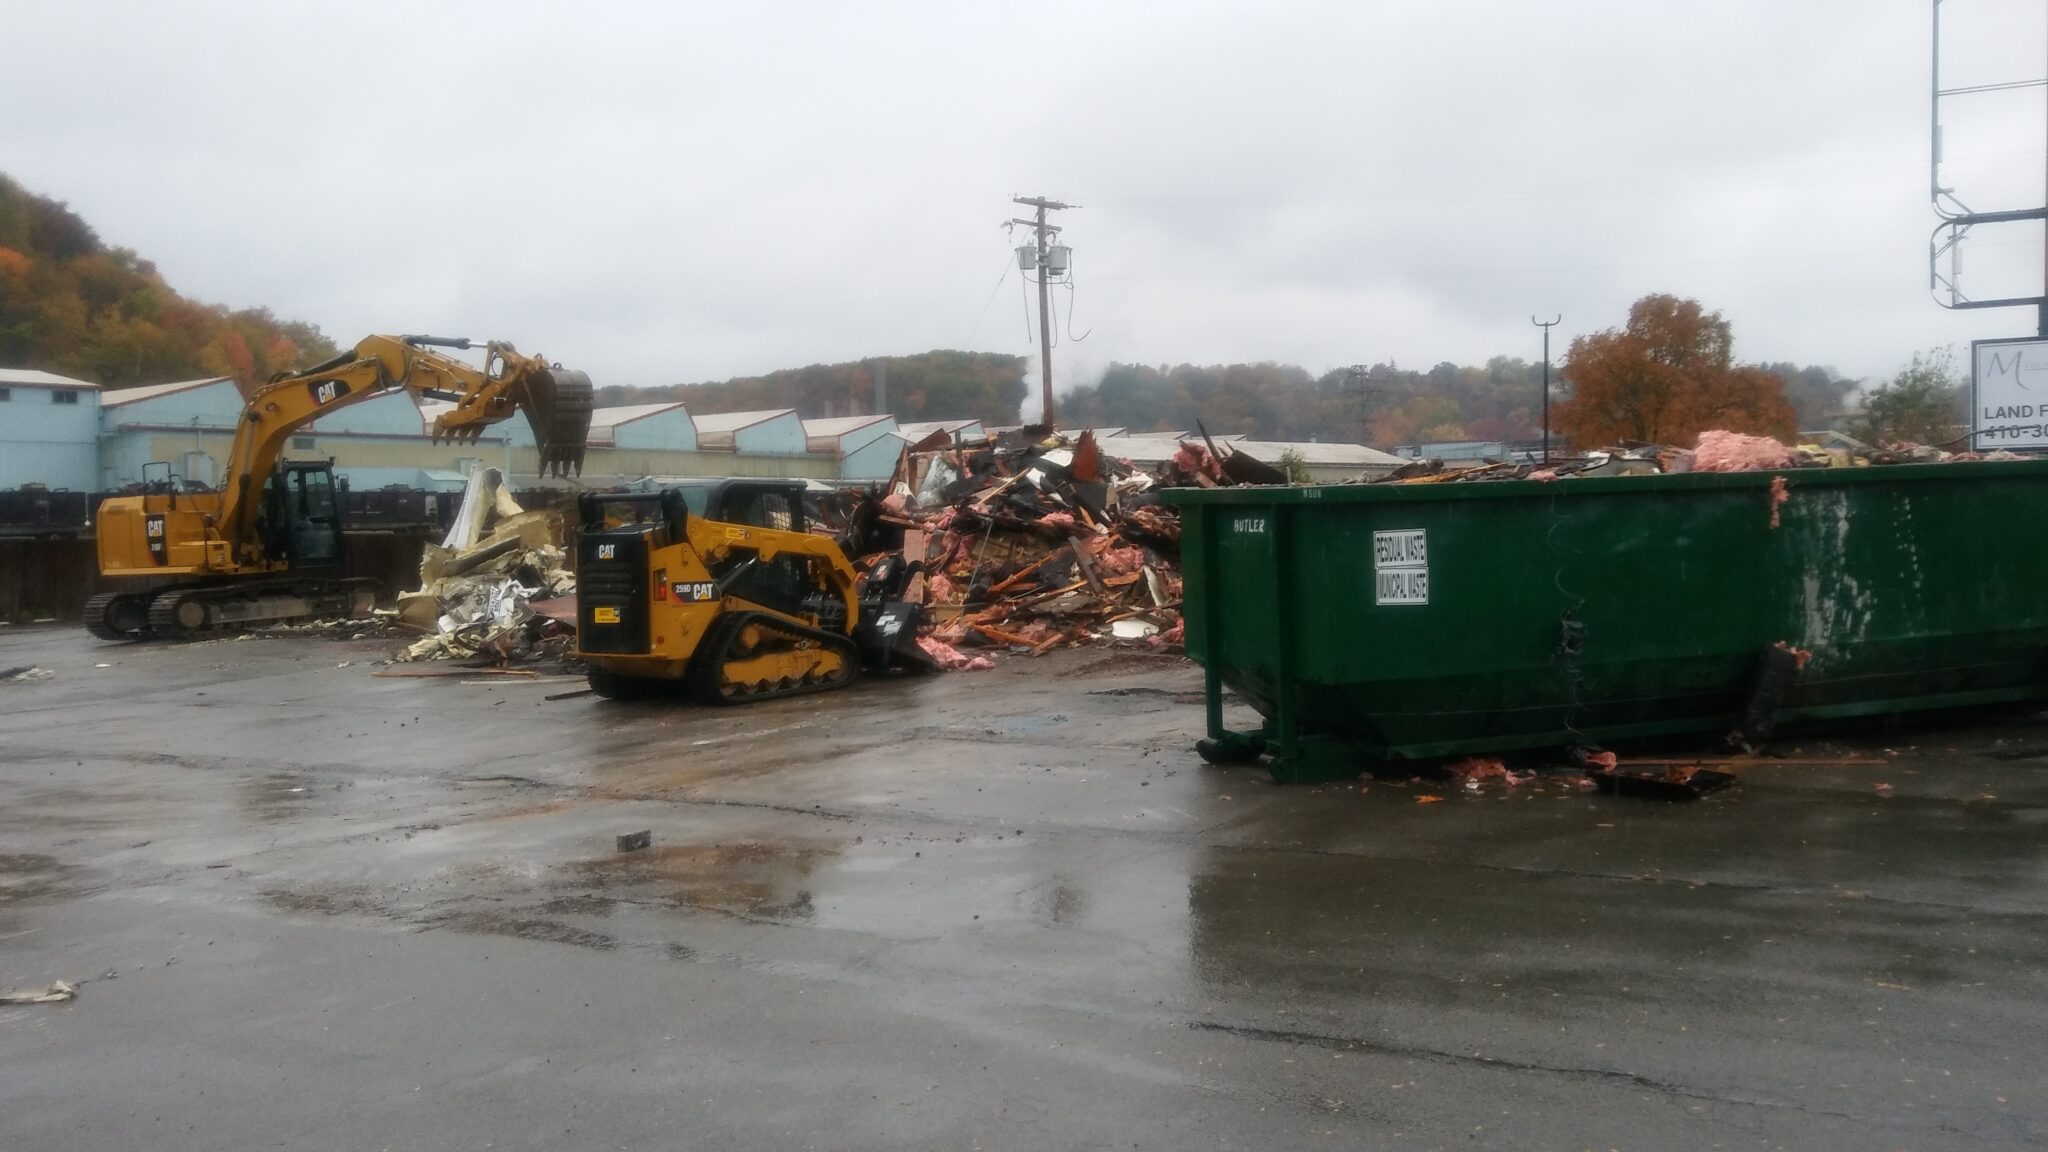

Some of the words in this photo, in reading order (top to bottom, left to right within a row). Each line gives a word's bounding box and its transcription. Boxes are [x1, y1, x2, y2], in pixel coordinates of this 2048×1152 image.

[318, 381, 336, 404] CAT
[1984, 405, 2034, 420] LAND
[147, 520, 163, 537] CAT
[1233, 519, 1265, 533] BUTLER
[598, 544, 616, 560] CAT
[1376, 536, 1405, 563] RESIDUAL
[1404, 535, 1424, 561] WASTE
[693, 583, 714, 600] CAT
[1407, 573, 1426, 599] WASTE
